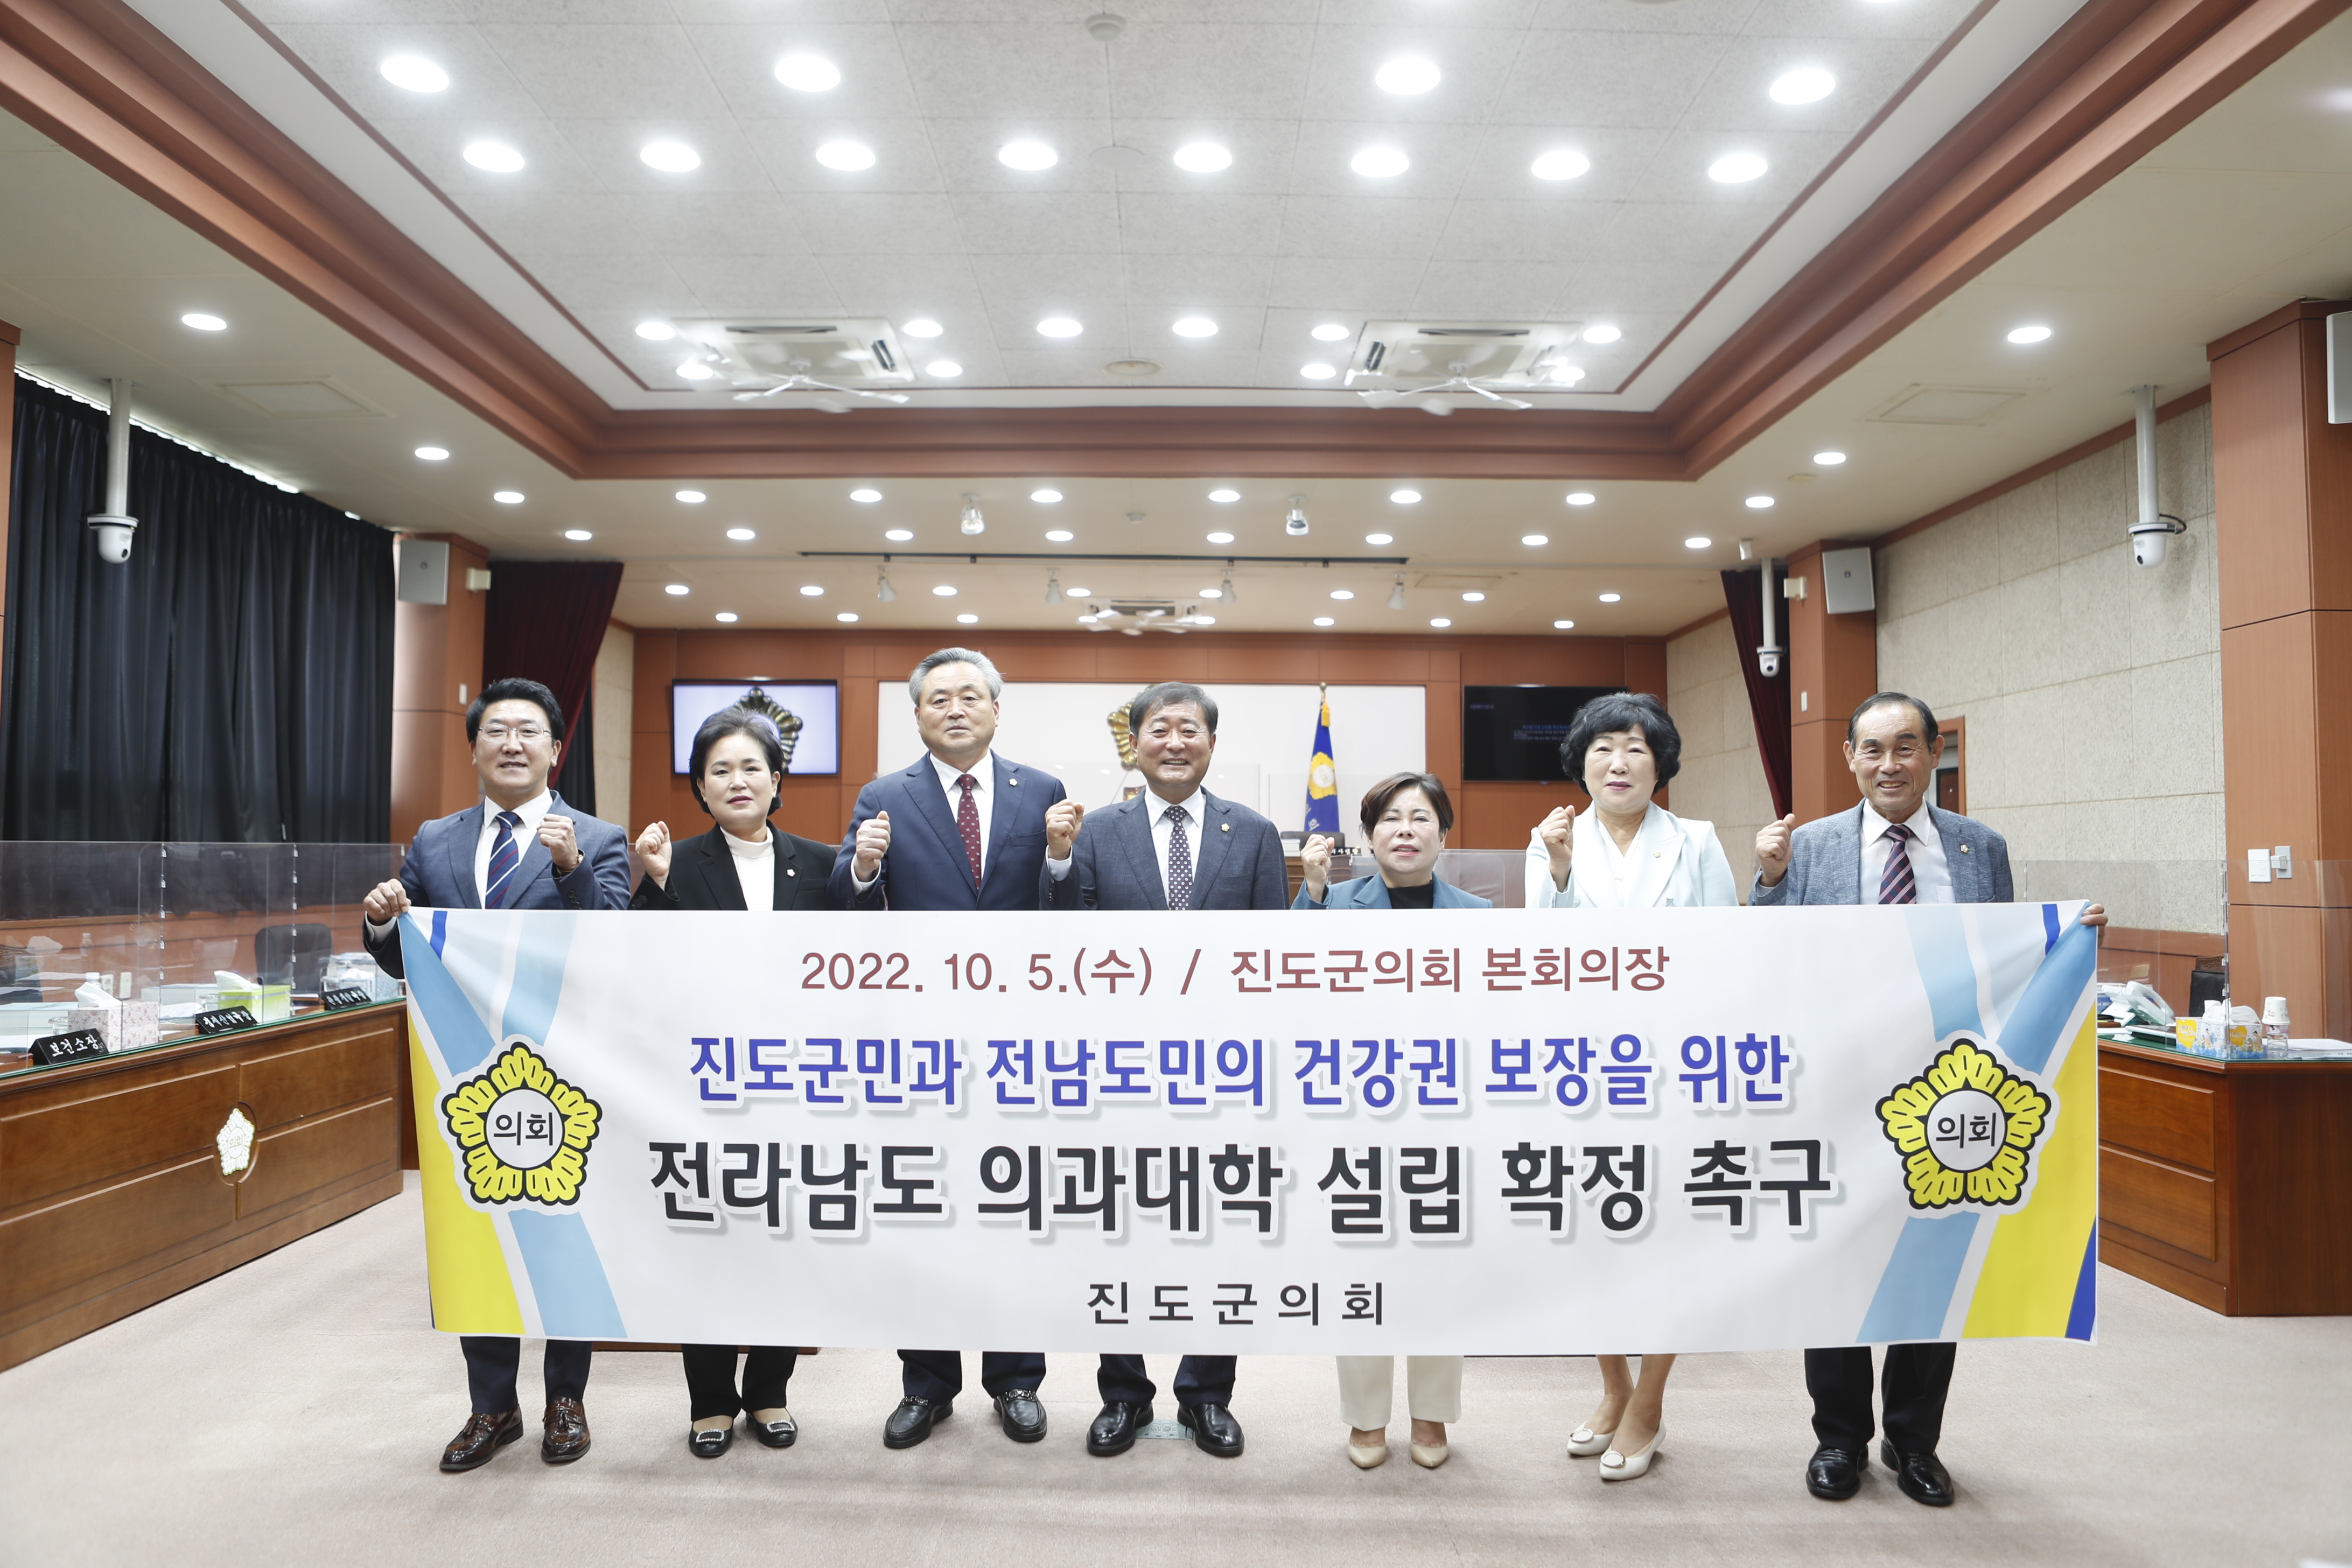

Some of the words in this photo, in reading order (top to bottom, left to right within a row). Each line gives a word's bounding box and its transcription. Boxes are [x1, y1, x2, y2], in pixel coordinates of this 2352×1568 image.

[801, 952, 923, 992] 2022.
[945, 953, 1007, 992] 10.
[1030, 947, 1152, 995] 5.(수)
[1181, 948, 1201, 995] /
[1231, 948, 1460, 993] 진도군의회
[1482, 946, 1670, 992] 본회의장
[202, 1010, 251, 1028] 경제산업국장
[50, 1034, 98, 1056] 보건소장
[690, 1037, 962, 1105] 진도군민과
[987, 1039, 1263, 1107] 전남도민의
[1296, 1038, 1458, 1108] 건강권
[1486, 1034, 1653, 1106] 보장을
[1679, 1033, 1790, 1103] 위한
[229, 1134, 242, 1150] 의회
[493, 1111, 554, 1146] 의회
[1936, 1112, 1996, 1149] 의회
[648, 1142, 942, 1230] 전라남도
[978, 1144, 1283, 1233] 의과대학
[1317, 1146, 1460, 1234] 설립
[1501, 1142, 1645, 1231] 확정
[1683, 1139, 1831, 1226] 촉구
